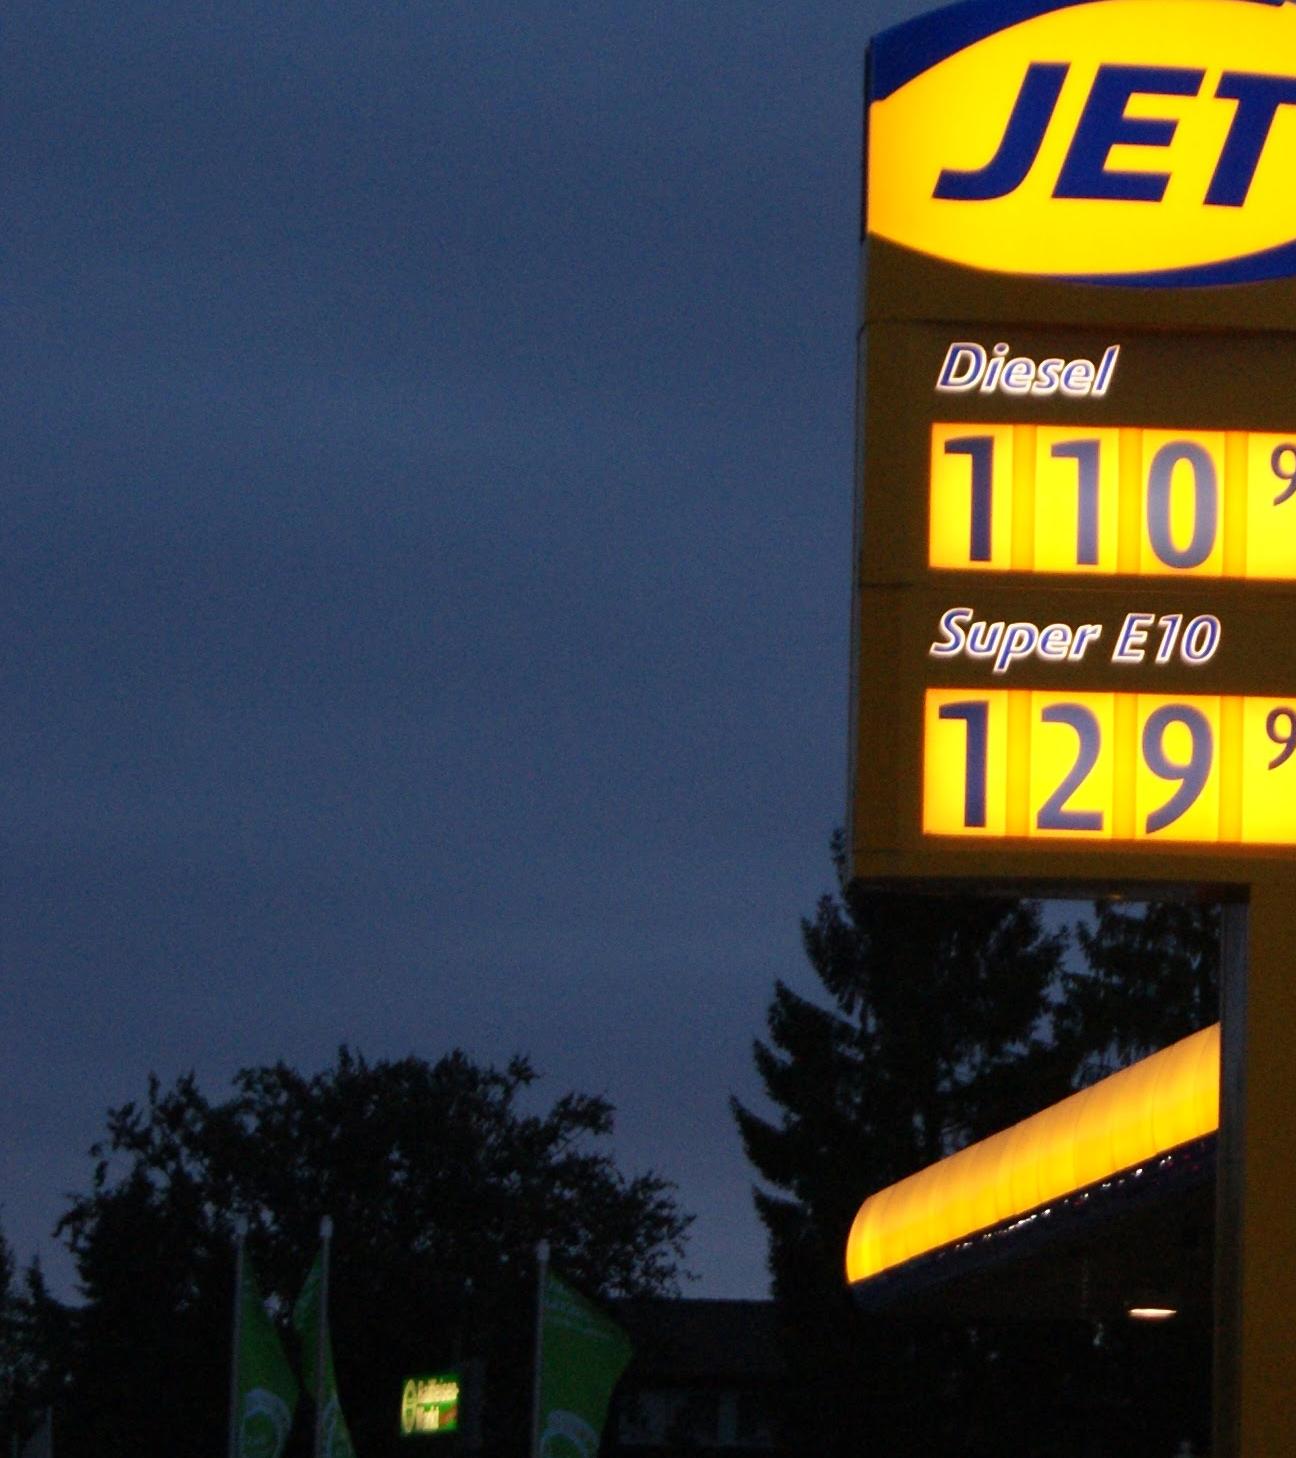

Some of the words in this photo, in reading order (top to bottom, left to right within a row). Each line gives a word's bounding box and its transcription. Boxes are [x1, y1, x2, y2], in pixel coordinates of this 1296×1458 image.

[935, 341, 1120, 397] Diesel
[930, 607, 1102, 672] Super
[1111, 612, 1221, 663] E10
